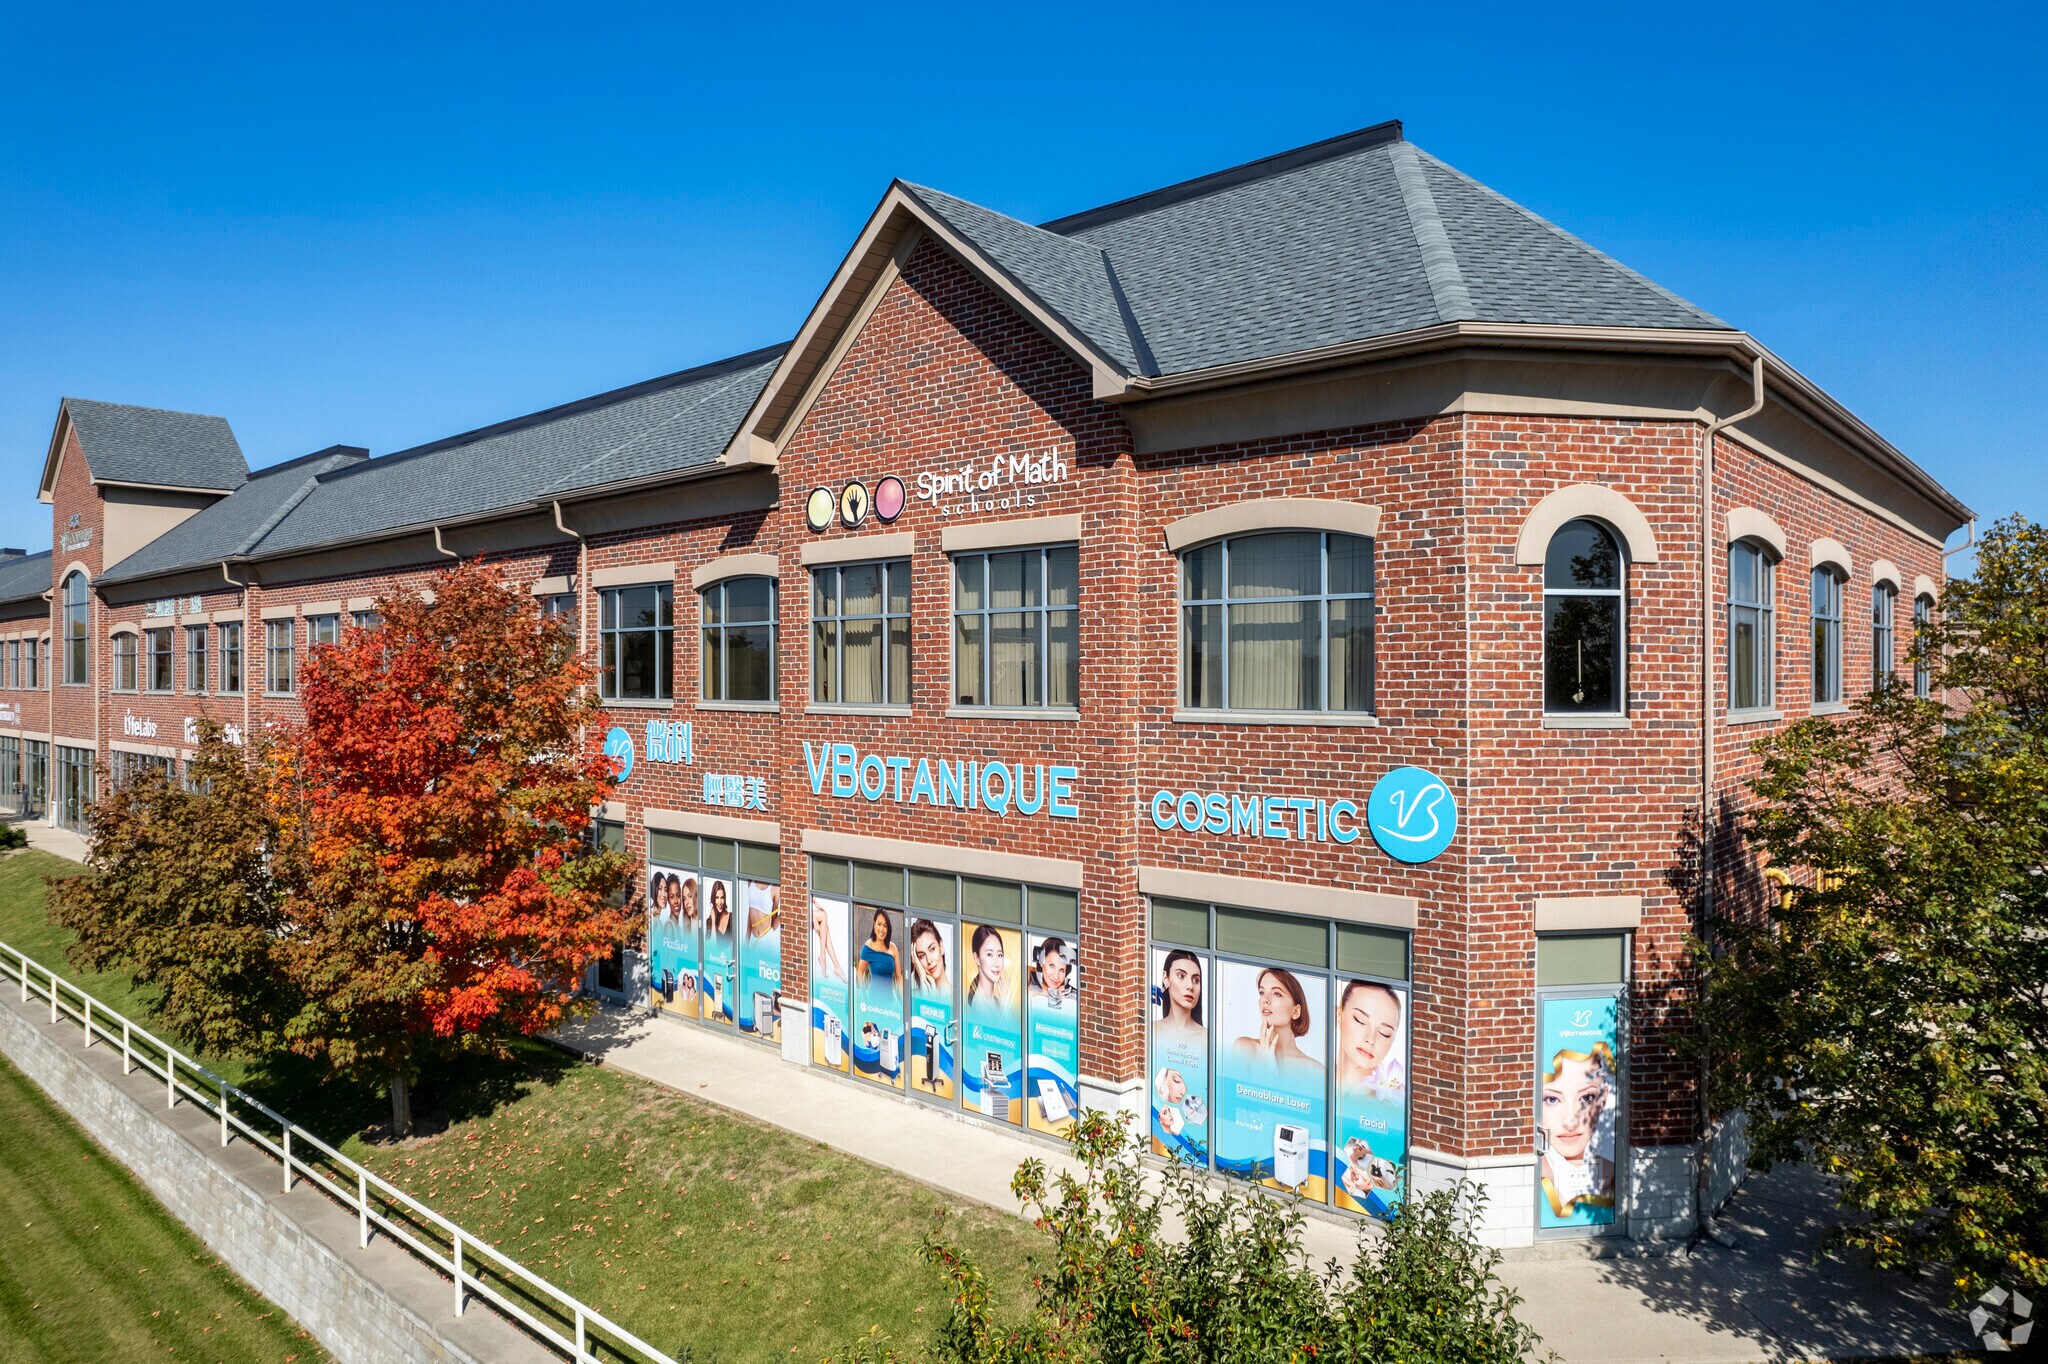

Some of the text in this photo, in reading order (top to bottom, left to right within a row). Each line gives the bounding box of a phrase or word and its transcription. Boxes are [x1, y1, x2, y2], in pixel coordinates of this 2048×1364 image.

[916, 446, 1067, 506] Spirit of Math
[942, 490, 1035, 517] schools
[645, 719, 694, 766] 微科
[703, 773, 768, 812] 輕醫美
[1151, 789, 1361, 844] COSMETIC
[662, 936, 689, 953] PicoSure
[758, 966, 781, 982] neo
[1236, 1083, 1310, 1111] Dermablate Laser
[1360, 1115, 1387, 1131] Facial
